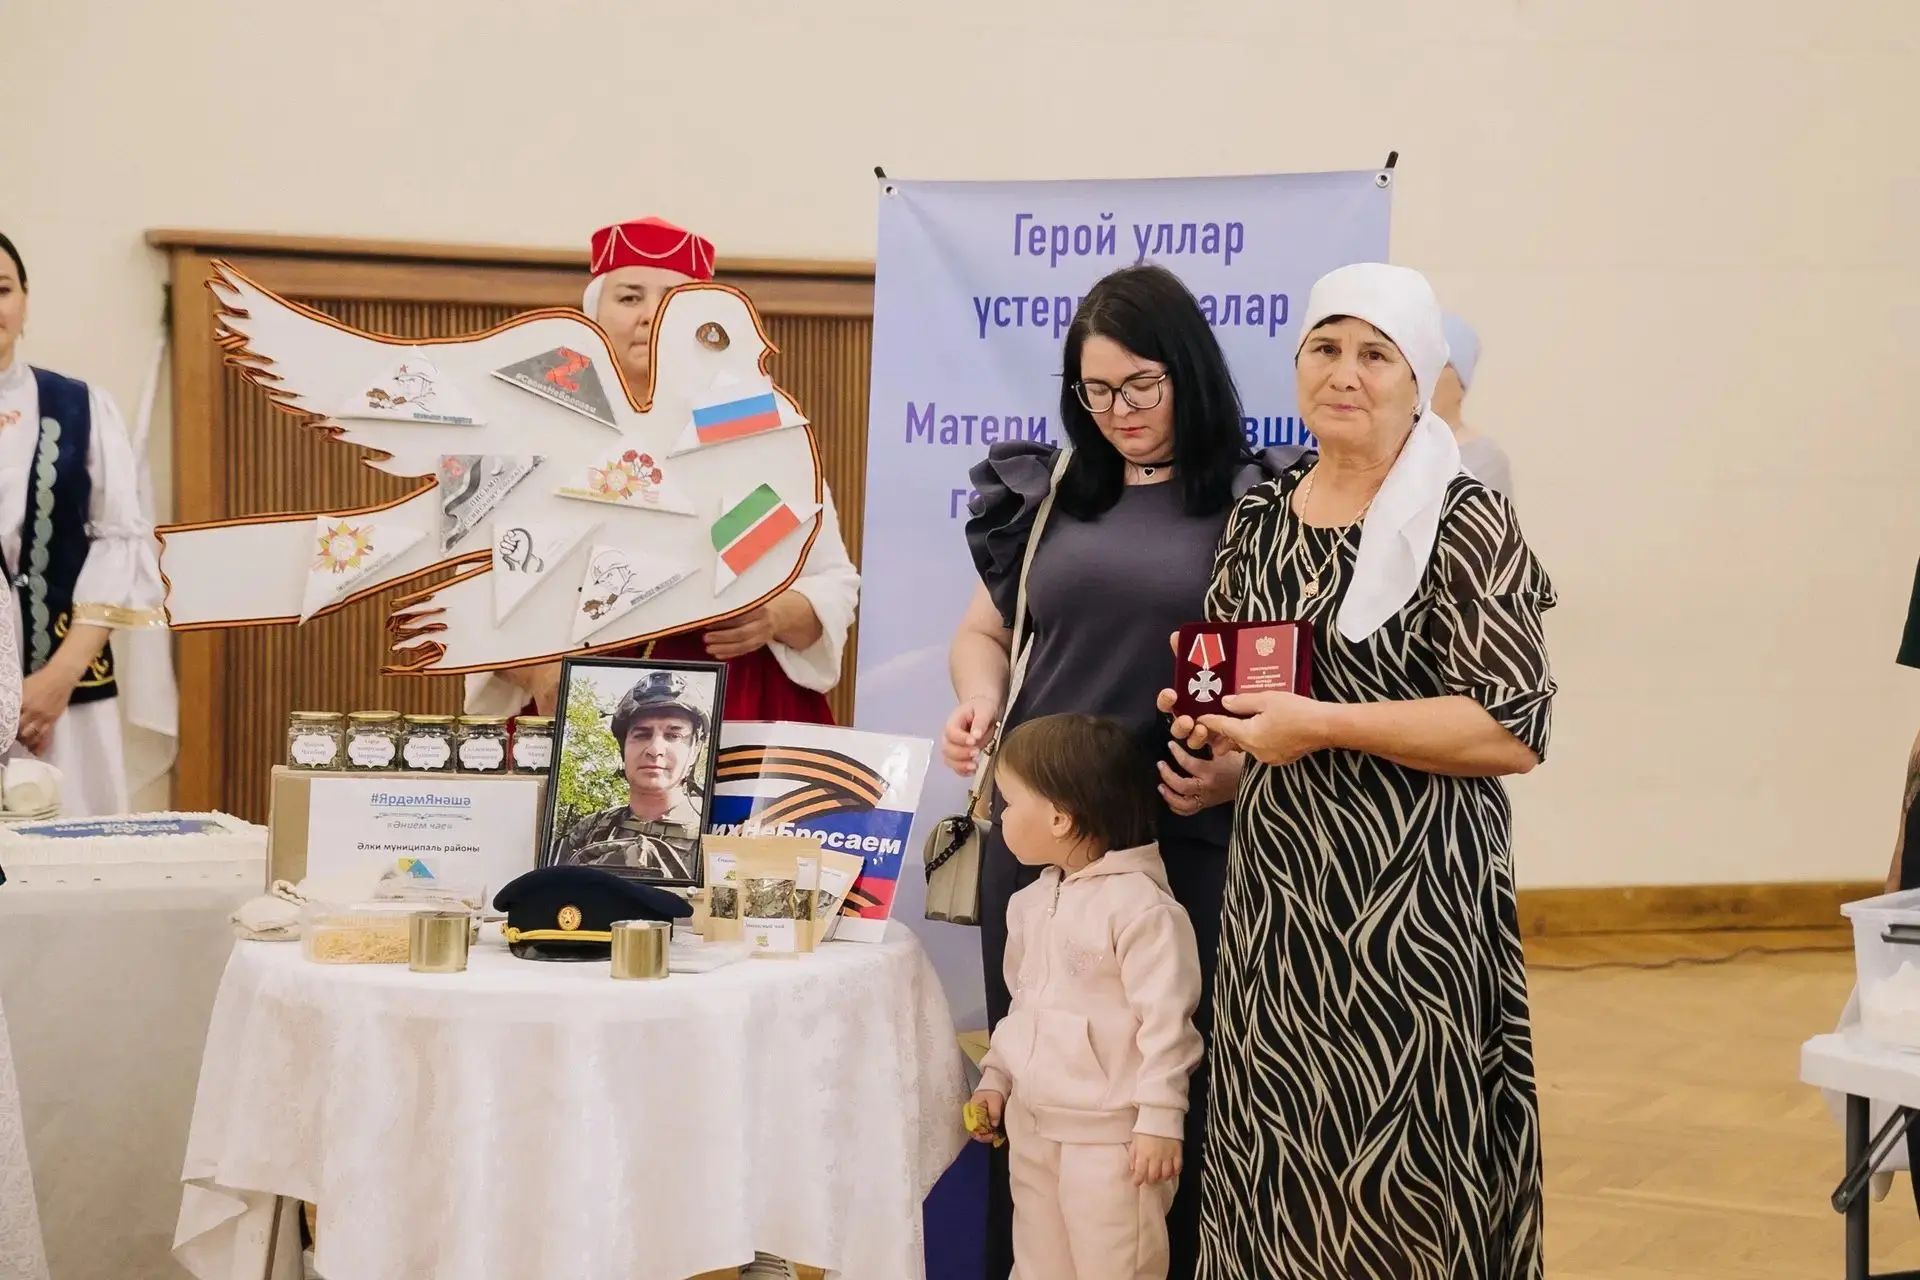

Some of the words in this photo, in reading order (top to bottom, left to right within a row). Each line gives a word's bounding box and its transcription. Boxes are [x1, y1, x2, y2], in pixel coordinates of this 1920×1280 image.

[1013, 213, 1116, 267] Герой
[1133, 221, 1244, 267] уллар
[973, 296, 1086, 339] үстер
[1200, 293, 1289, 338] алар
[371, 793, 471, 807] #ЯрдәмЯнәшә
[357, 842, 381, 851] Әлки
[384, 843, 442, 853] муниципаль
[444, 843, 480, 853] районы
[711, 819, 901, 855] ихНеБросаем
